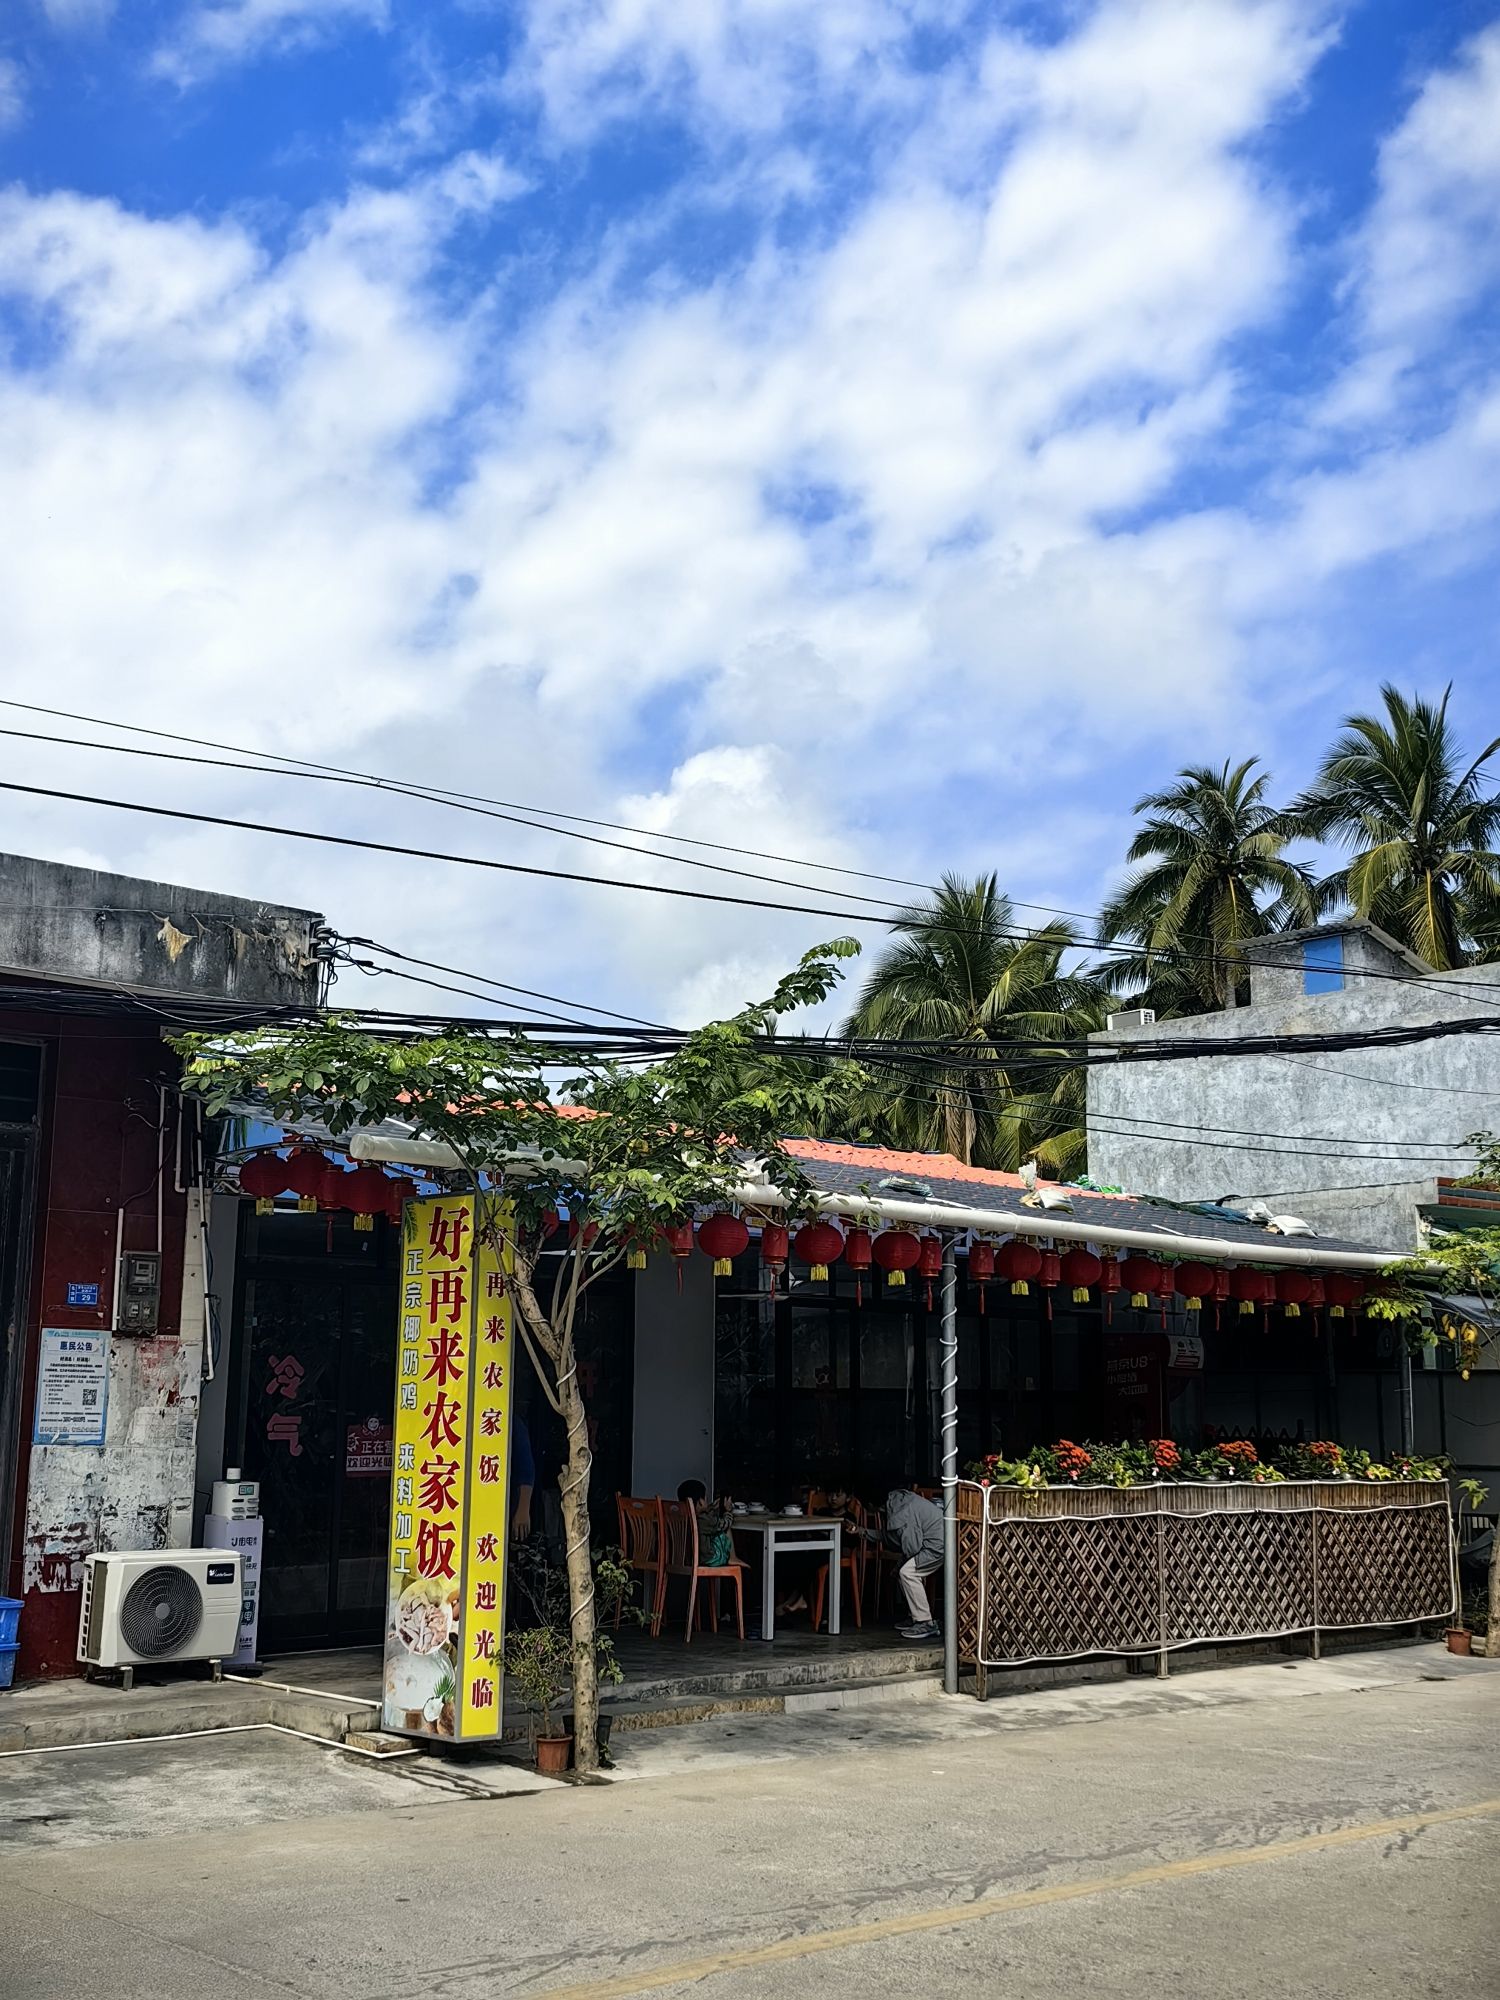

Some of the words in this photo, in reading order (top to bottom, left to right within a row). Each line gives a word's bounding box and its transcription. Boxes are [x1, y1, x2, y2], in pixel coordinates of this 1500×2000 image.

[60, 1341, 93, 1351] 惠民公告
[81, 1294, 91, 1302] 29
[400, 1248, 424, 1410] 正宗椰奶鸡
[266, 1355, 305, 1457] 冷气
[415, 1206, 470, 1580] 好再来农家饭
[393, 1443, 415, 1574] 来料加工
[471, 1533, 499, 1709] 欢迎光临
